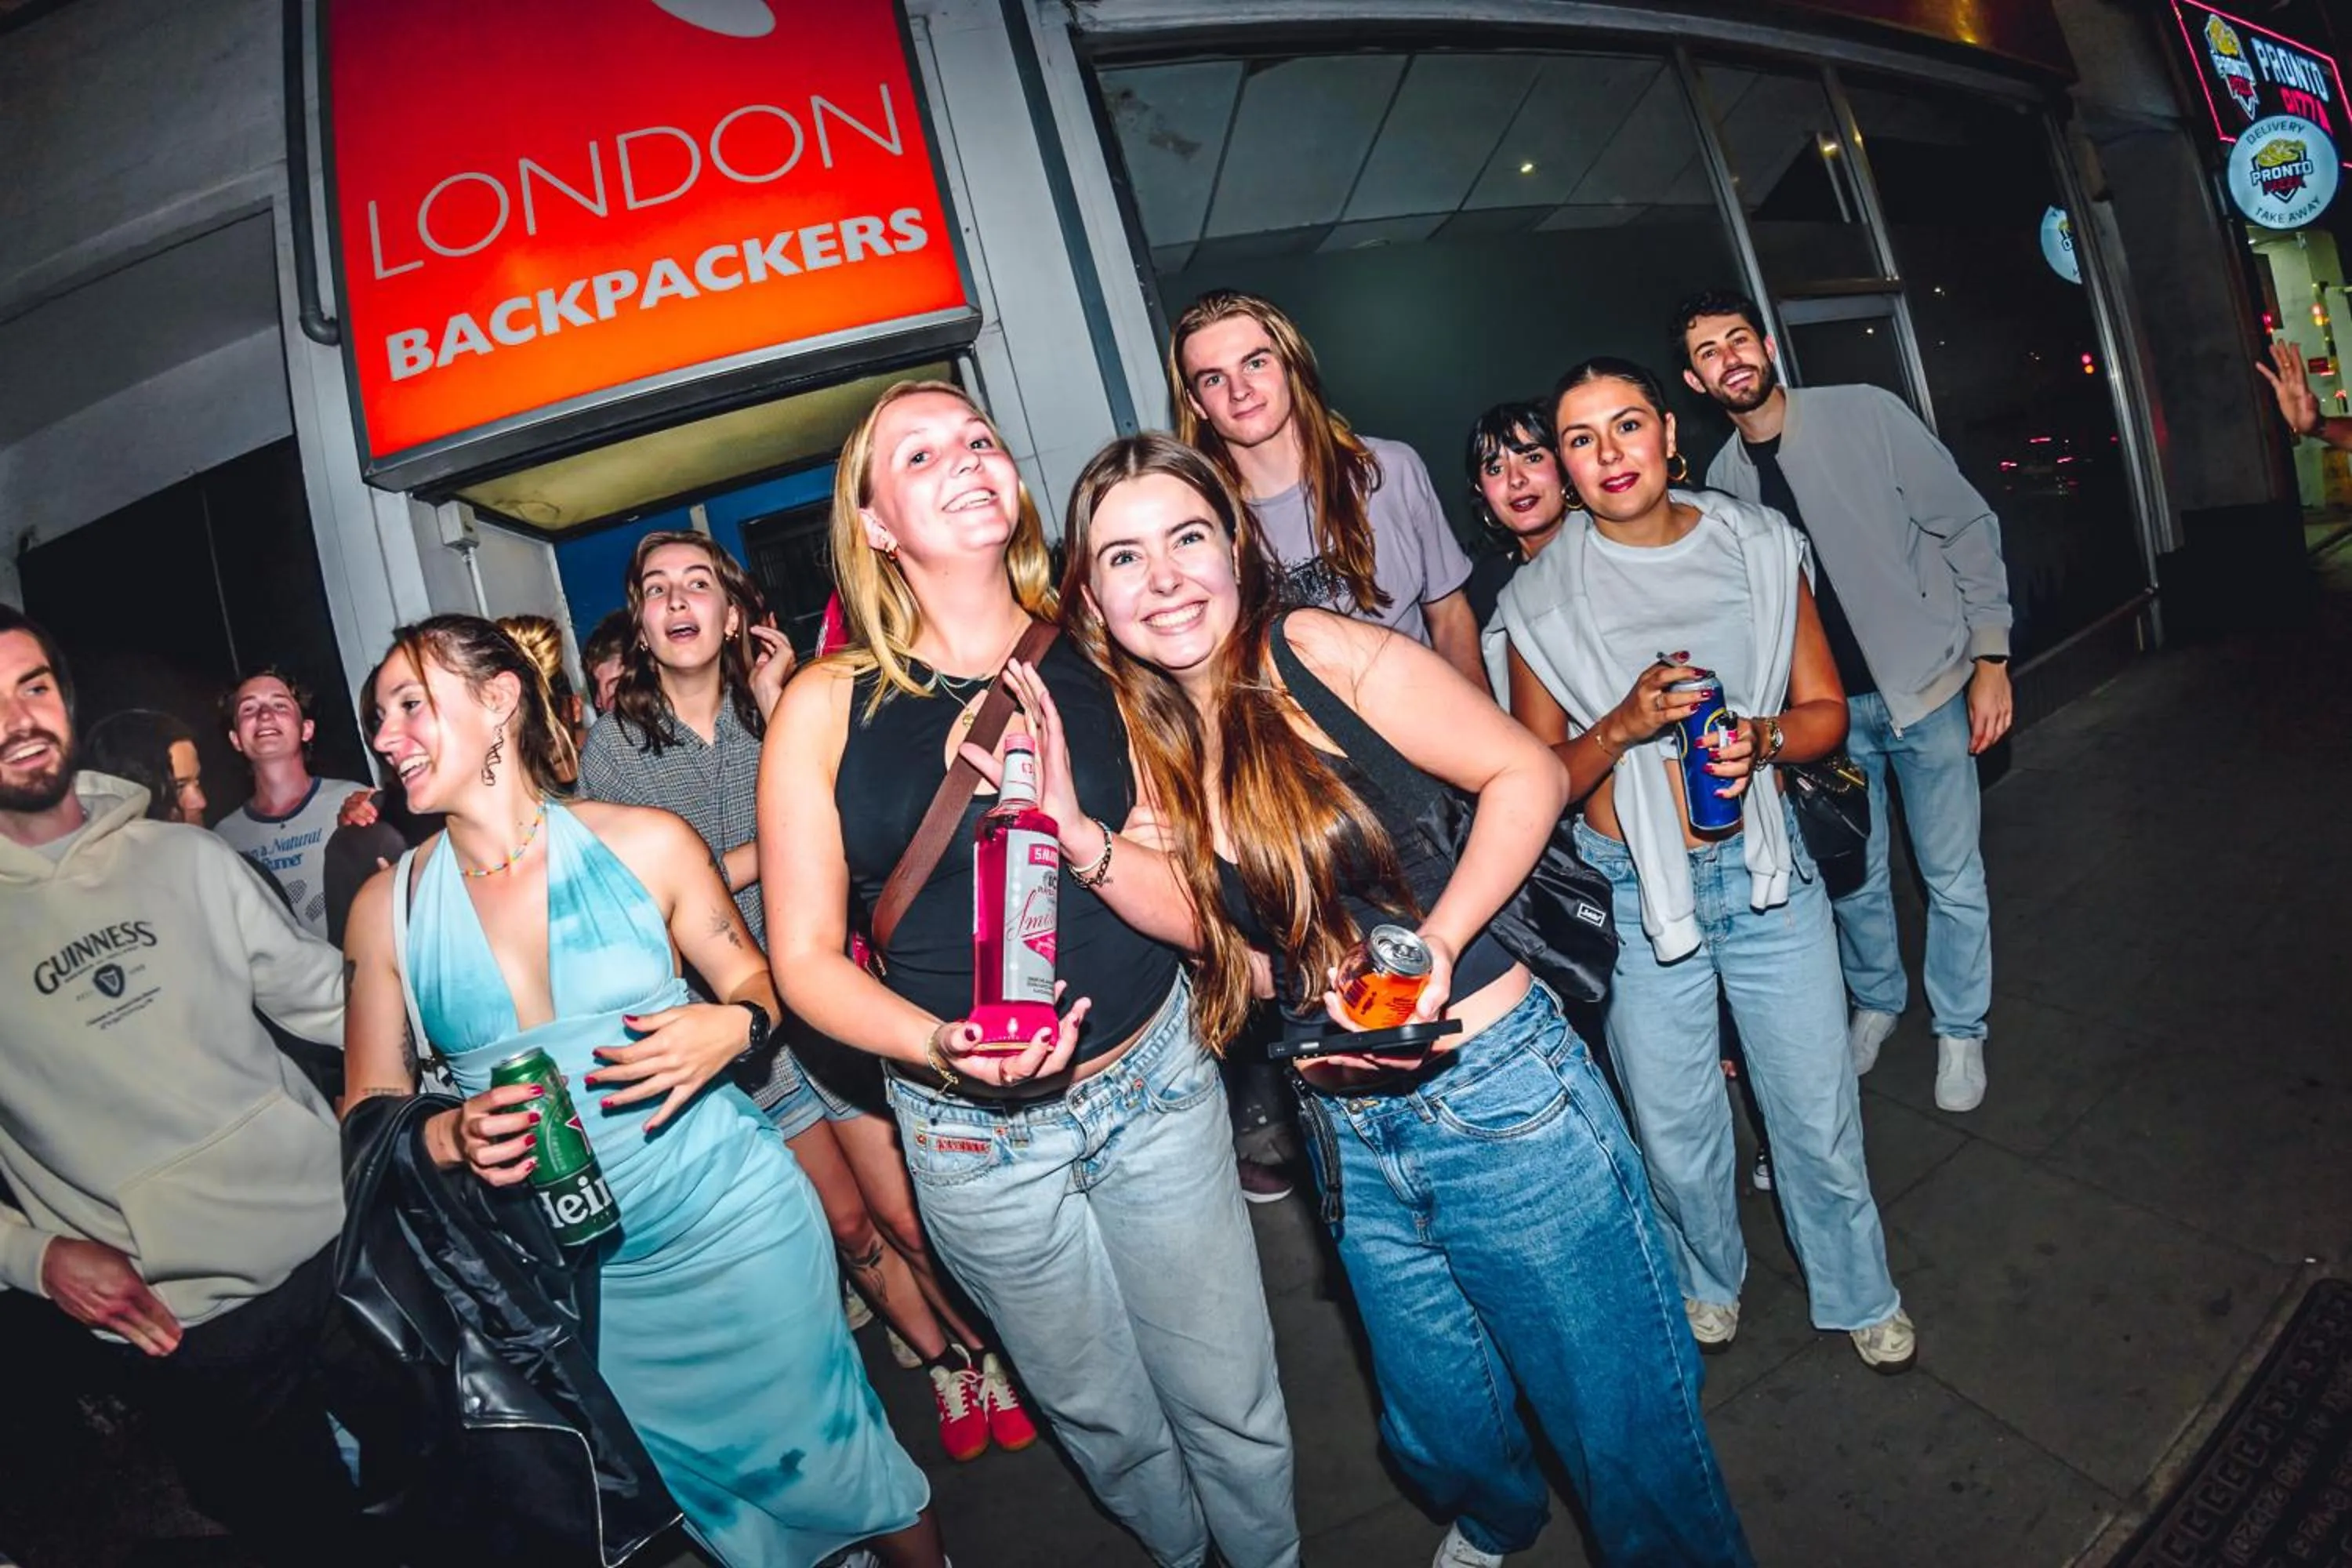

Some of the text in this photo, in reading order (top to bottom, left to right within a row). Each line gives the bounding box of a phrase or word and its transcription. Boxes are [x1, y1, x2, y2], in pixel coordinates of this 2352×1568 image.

[2251, 37, 2329, 103] PRONTO
[2245, 120, 2305, 145] DELIVERY
[367, 83, 904, 281] LONDON
[2250, 160, 2314, 186] PRONTO
[2256, 194, 2321, 223] TAKE AWAY
[387, 207, 929, 383] BACKPACKERS
[267, 827, 322, 854] Natural
[34, 920, 158, 996] GUINNESS
